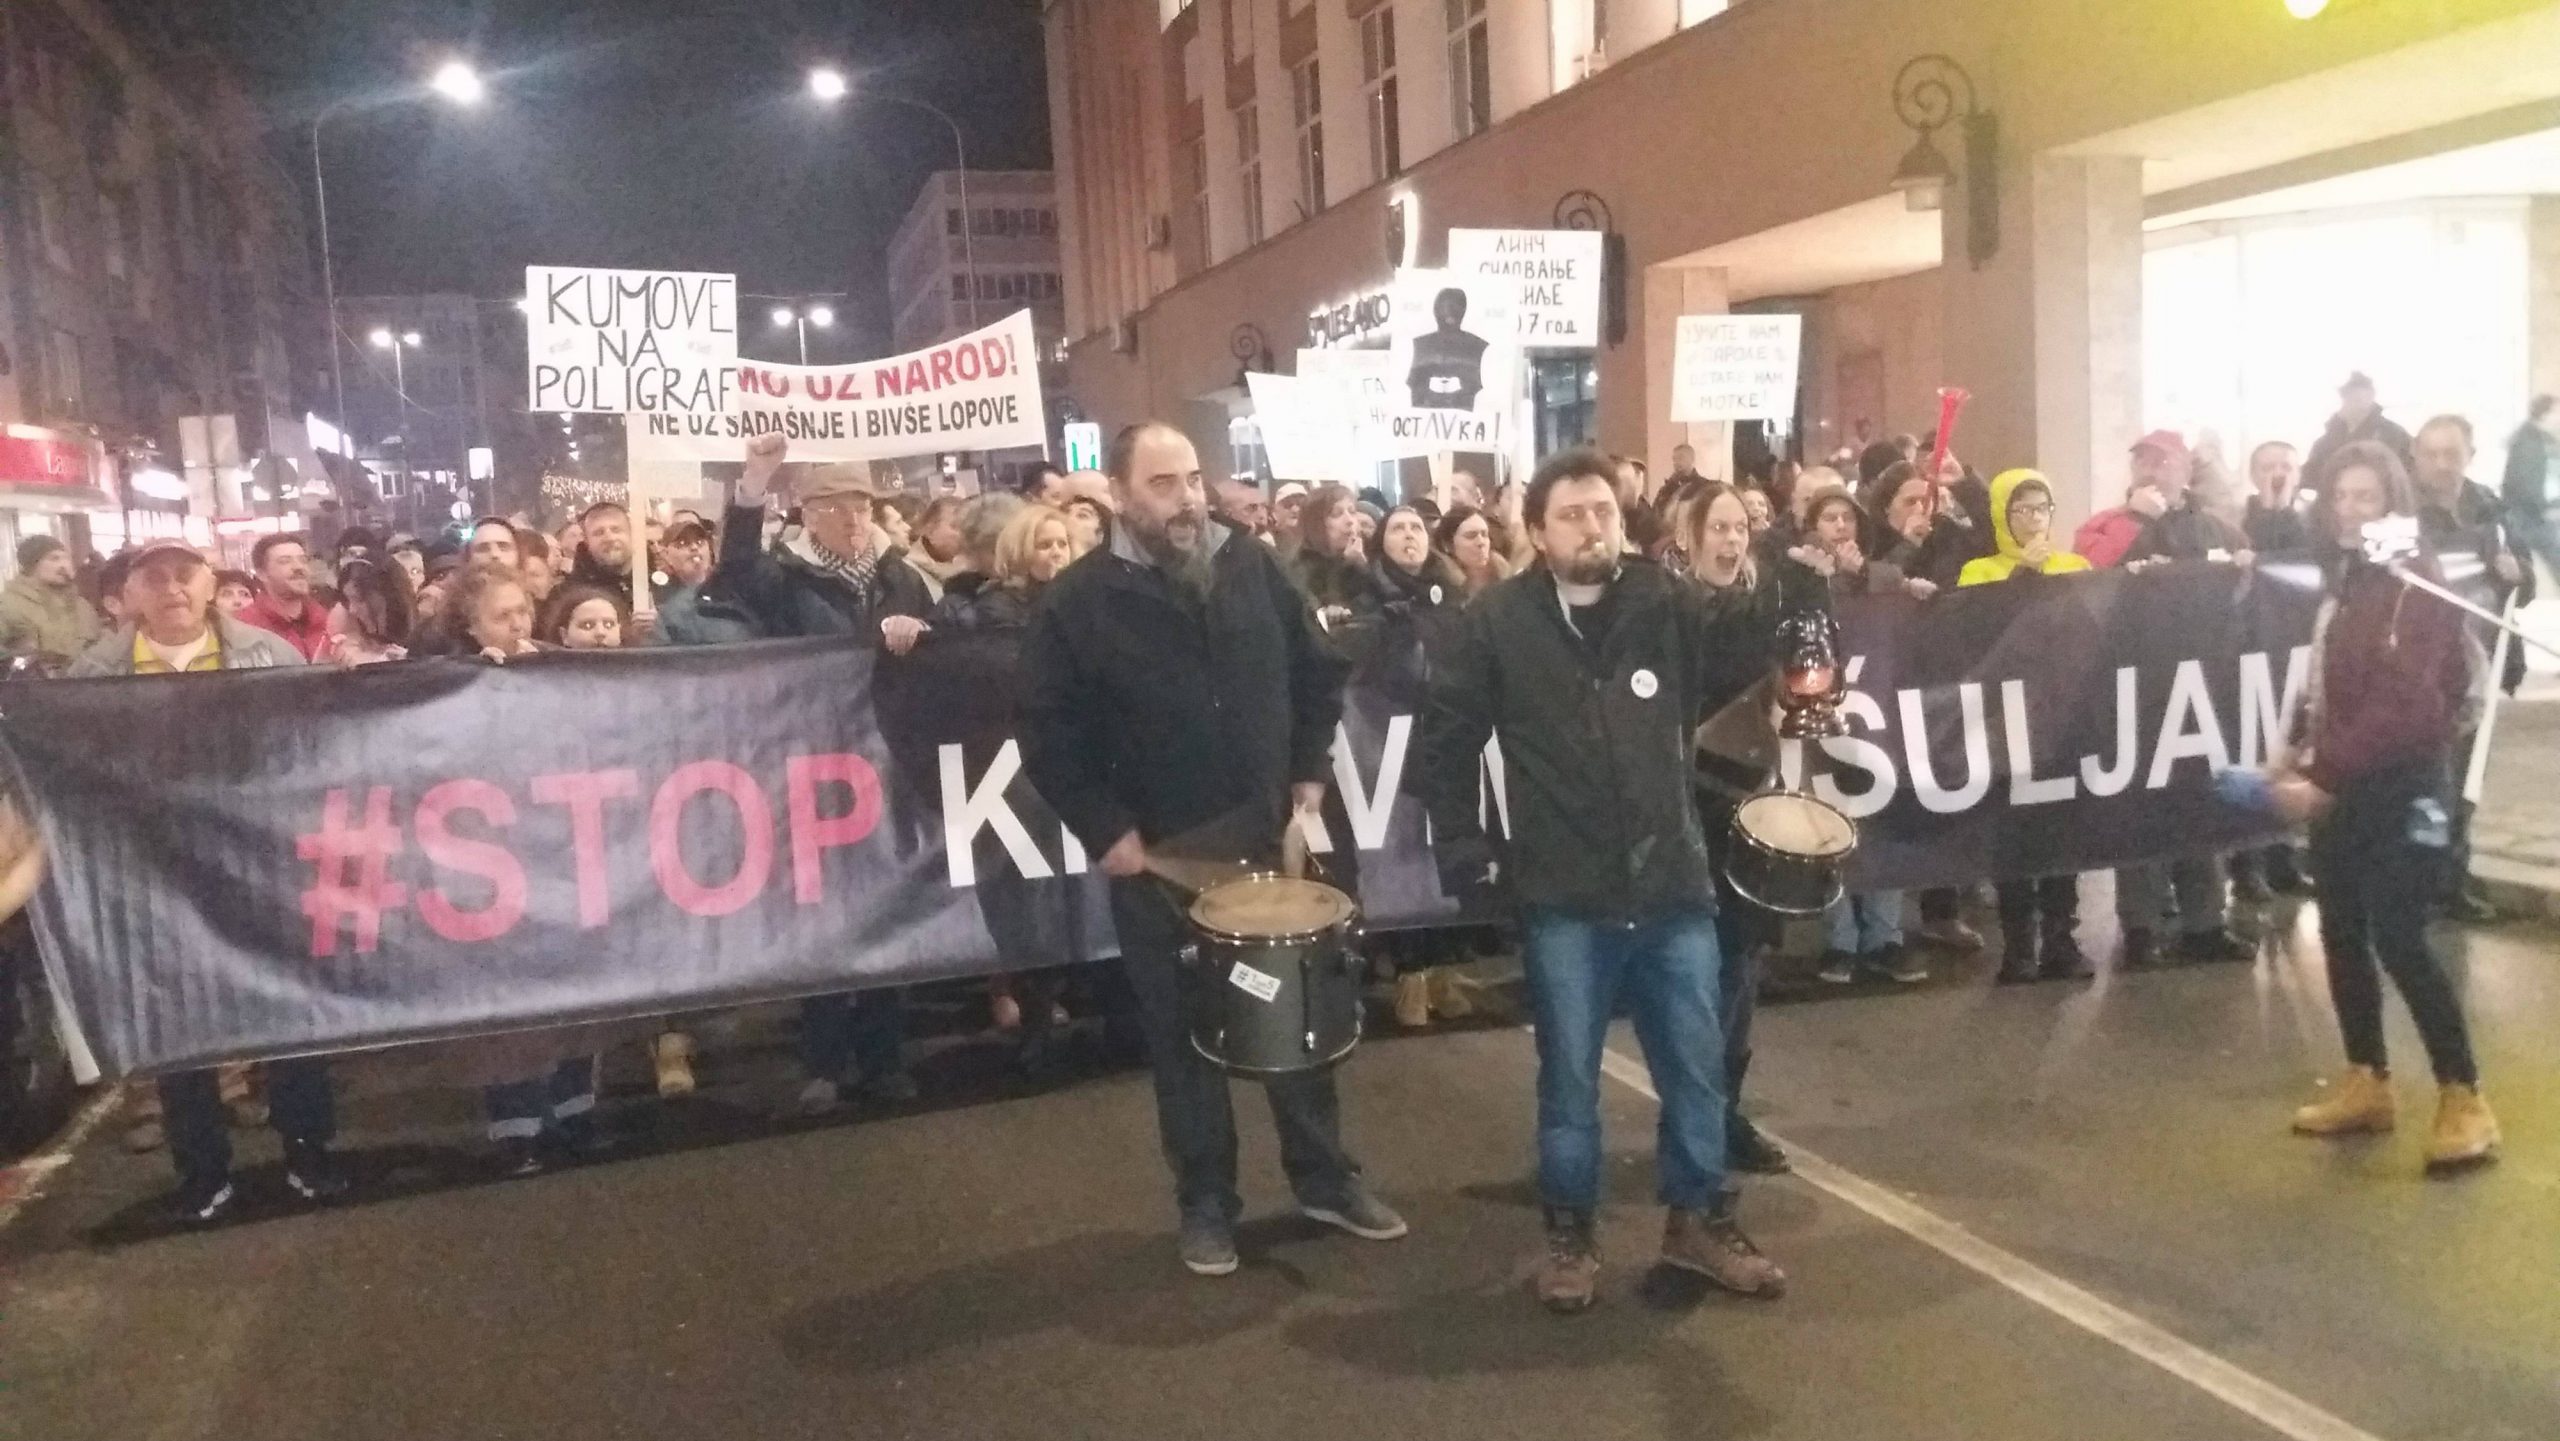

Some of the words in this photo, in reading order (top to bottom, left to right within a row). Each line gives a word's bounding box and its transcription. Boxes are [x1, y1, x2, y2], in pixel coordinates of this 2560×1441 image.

[1496, 234, 1546, 254] ЛИНЧ
[547, 273, 734, 333] KUMOVE
[1518, 283, 1564, 306] ИЉЕ
[598, 328, 667, 368] NA
[804, 373, 863, 402] UZ
[874, 332, 1019, 399] NAROD!
[535, 364, 738, 413] POLIGRAF
[648, 413, 681, 437] NE
[687, 413, 720, 437] UZ
[724, 402, 846, 441] SADAŠNJE
[852, 410, 860, 439] I
[866, 401, 933, 438] BIVŠE
[938, 394, 1020, 432] LOPOVE
[294, 752, 884, 957] #STOP
